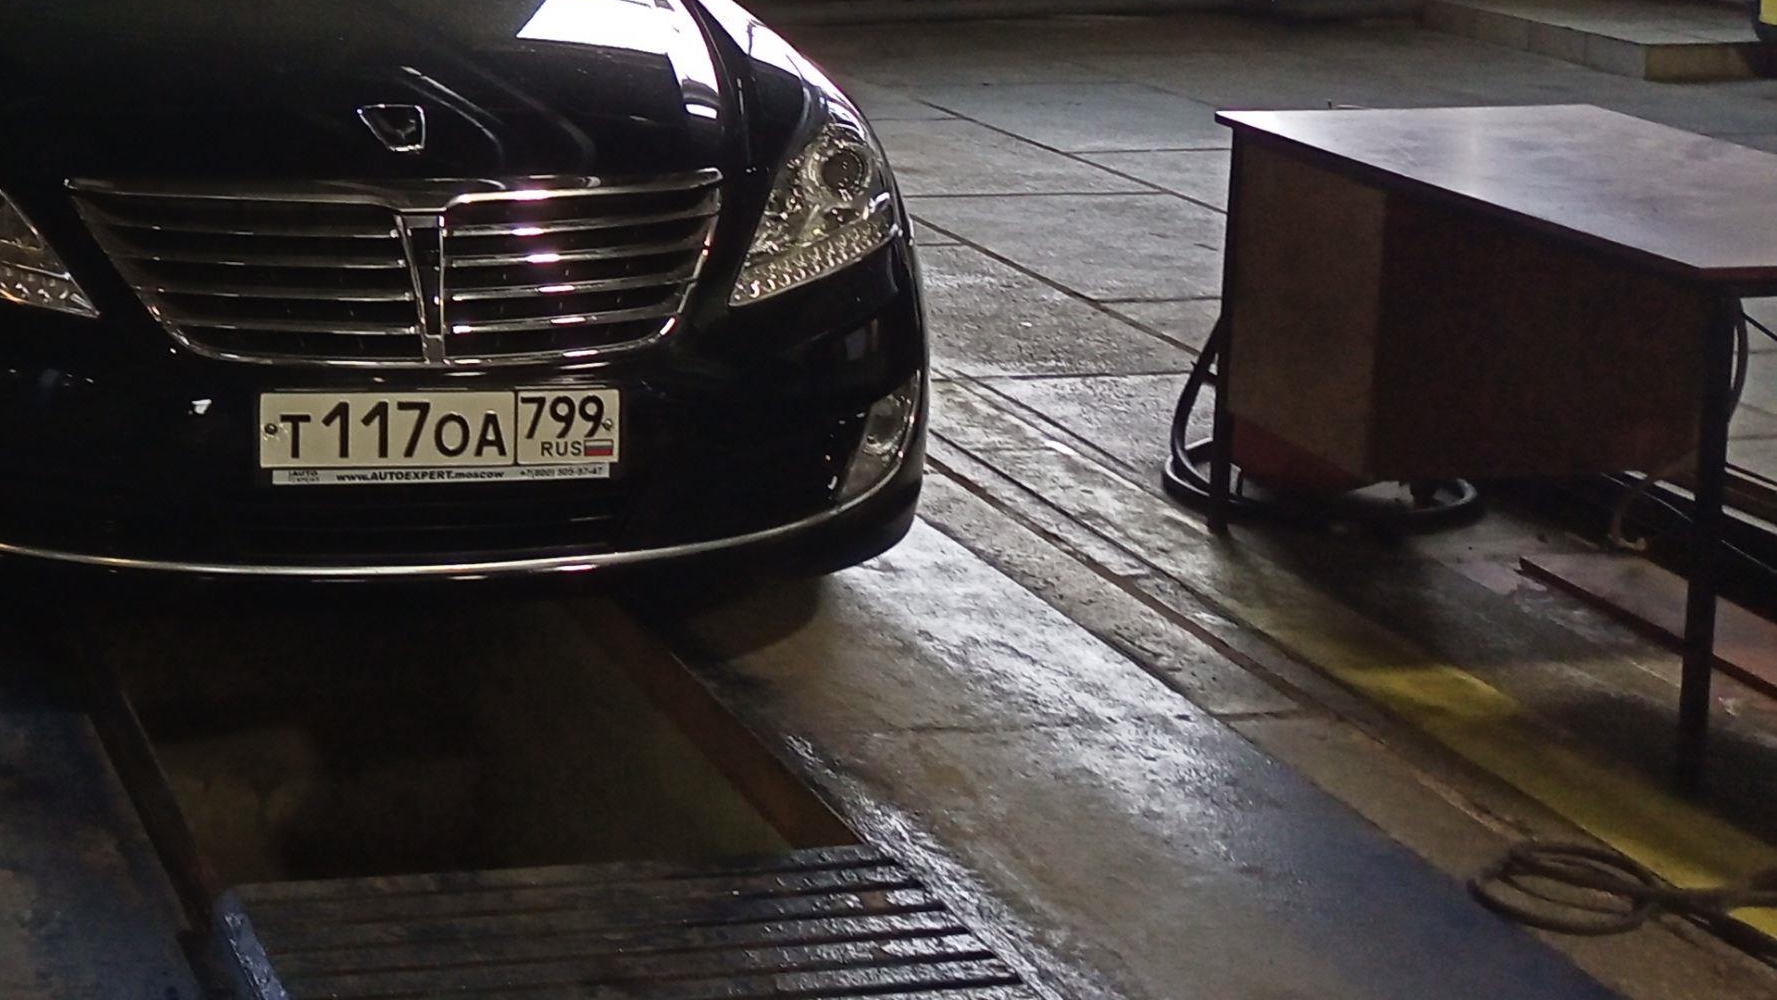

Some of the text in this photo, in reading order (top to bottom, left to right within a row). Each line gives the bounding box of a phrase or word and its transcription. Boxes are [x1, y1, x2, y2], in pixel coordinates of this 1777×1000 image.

[280, 402, 506, 458] Т117ОА
[520, 395, 605, 440] 799
[541, 441, 581, 456] RUS
[336, 469, 506, 482] www.AUTOEXPERT.moscow
